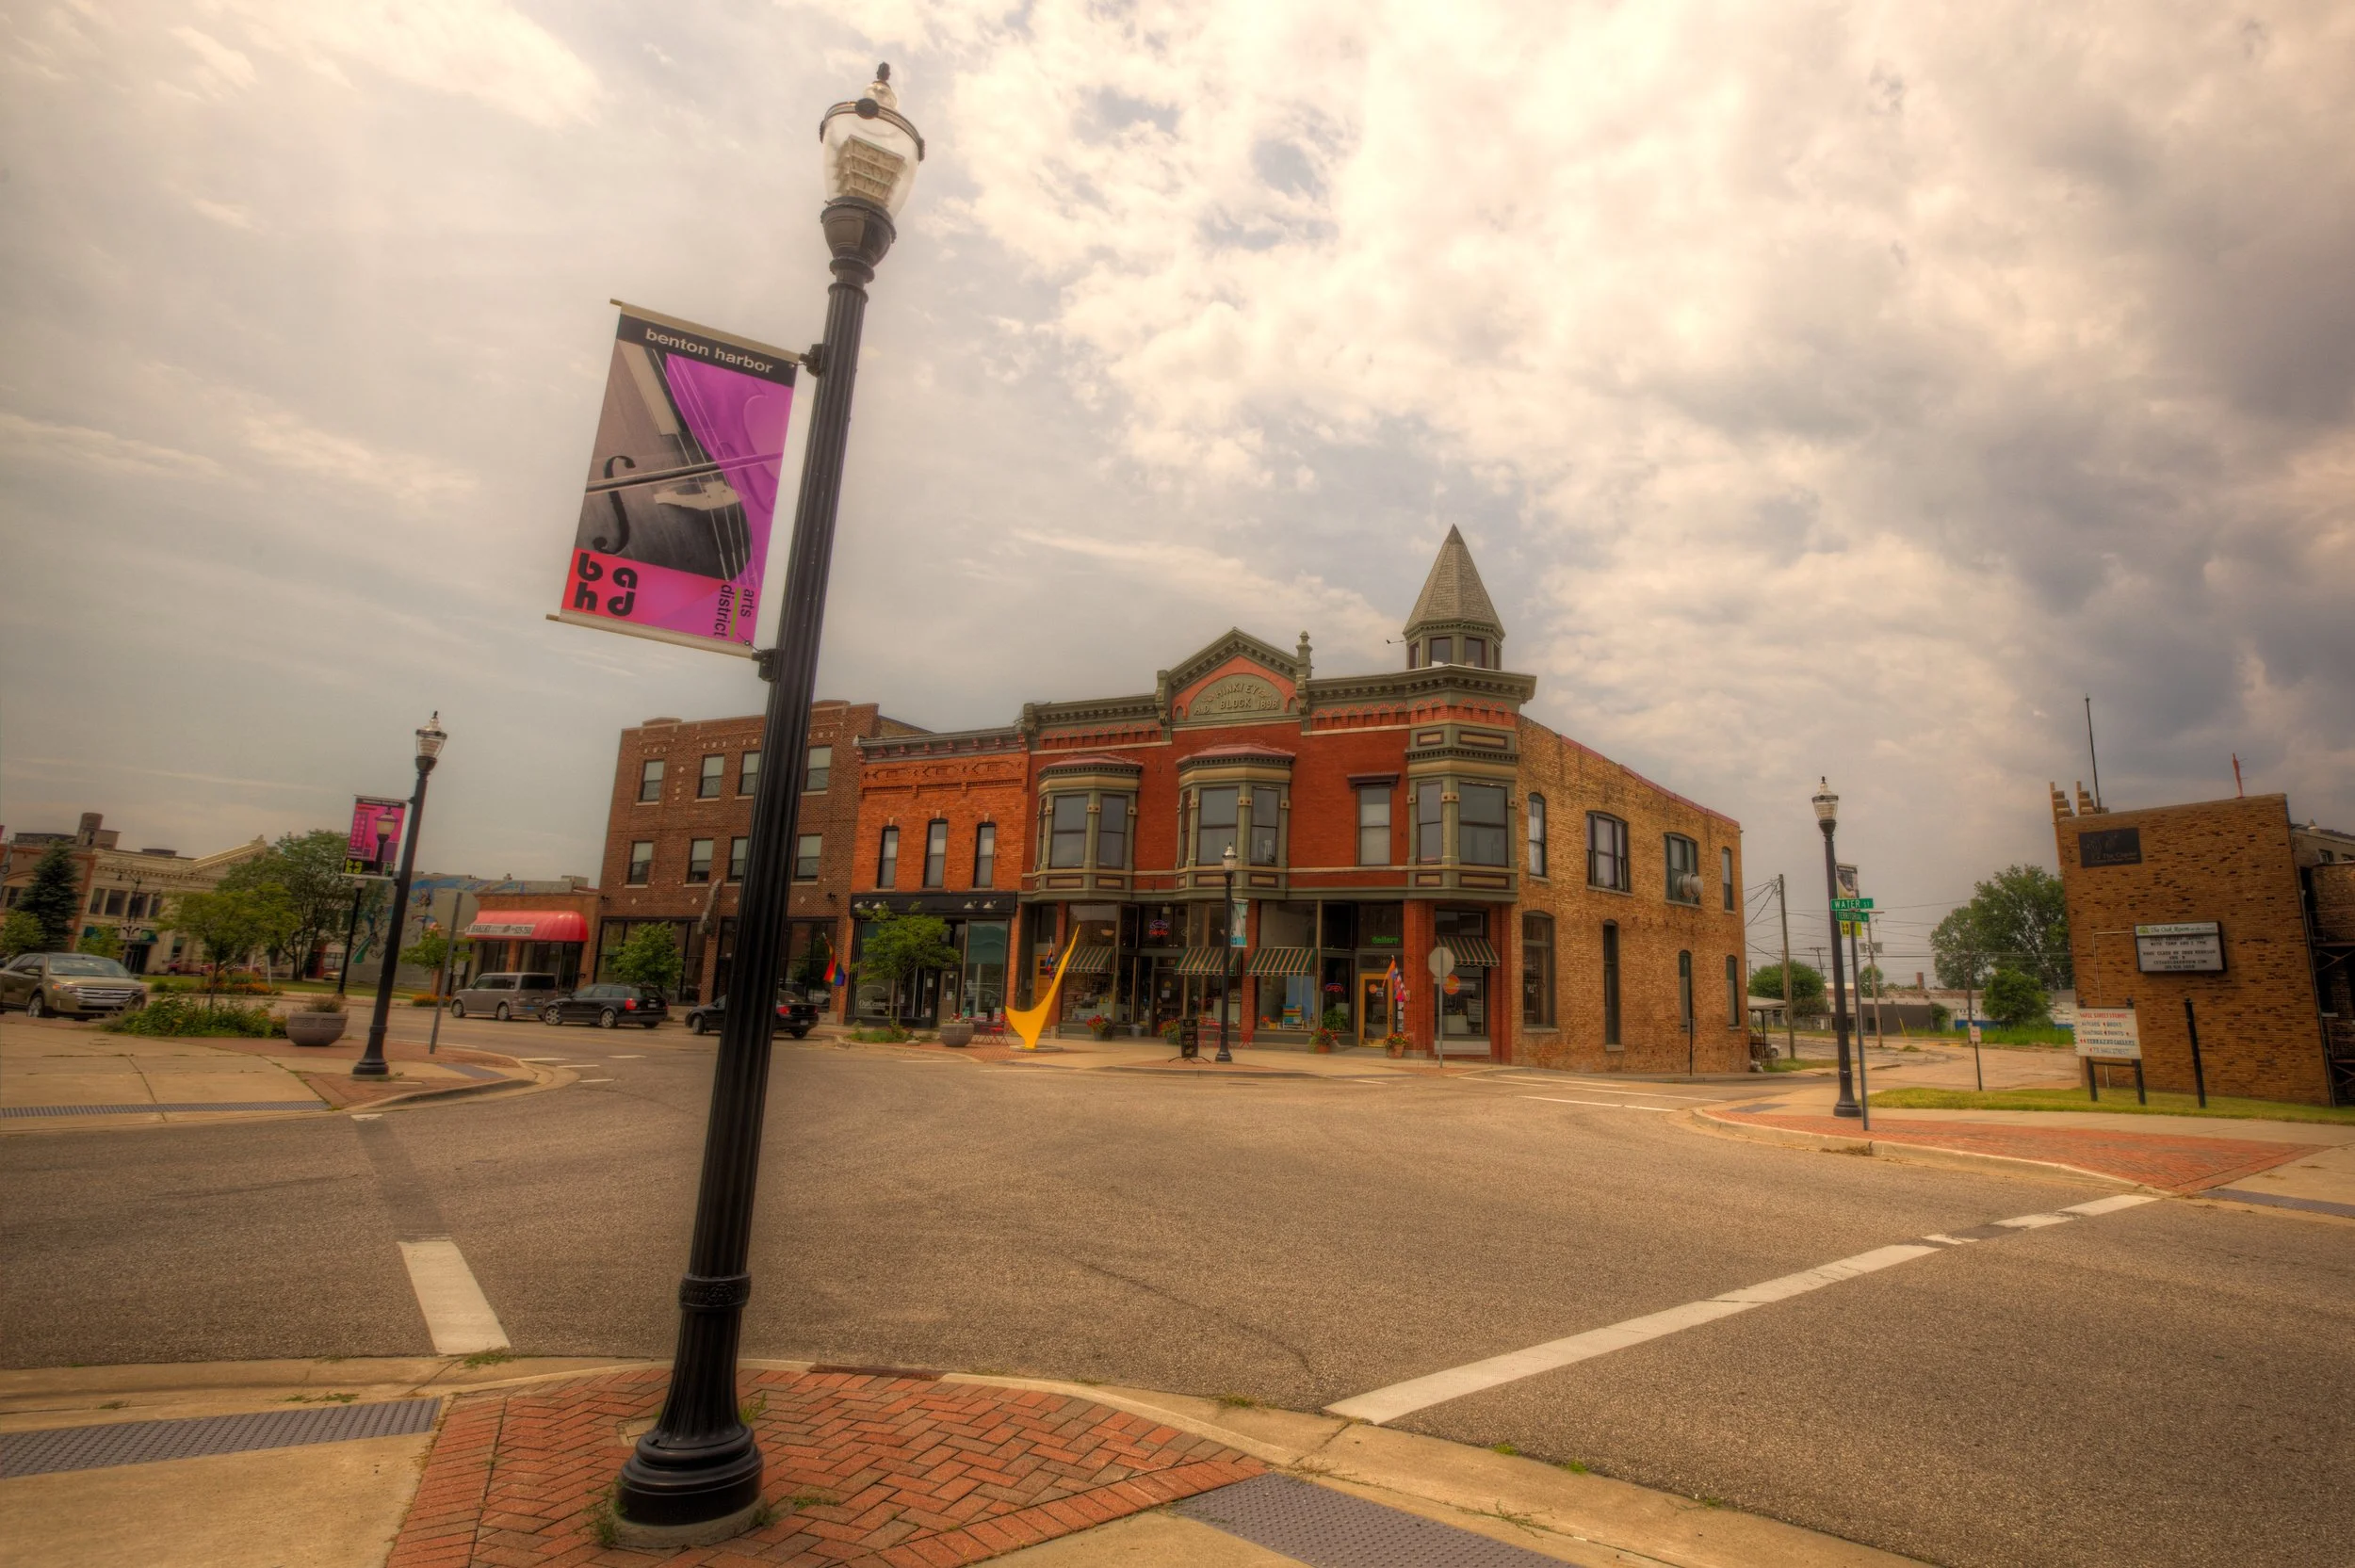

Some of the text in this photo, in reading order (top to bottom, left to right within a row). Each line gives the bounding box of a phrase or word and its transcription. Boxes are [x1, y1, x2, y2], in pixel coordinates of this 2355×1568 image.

[645, 328, 773, 374] benton harbor
[714, 583, 734, 638] district
[740, 588, 755, 618] arts
[1221, 698, 1252, 709] BLOCK
[1834, 899, 1860, 909] WATER
[1372, 936, 1399, 945] Gallery
